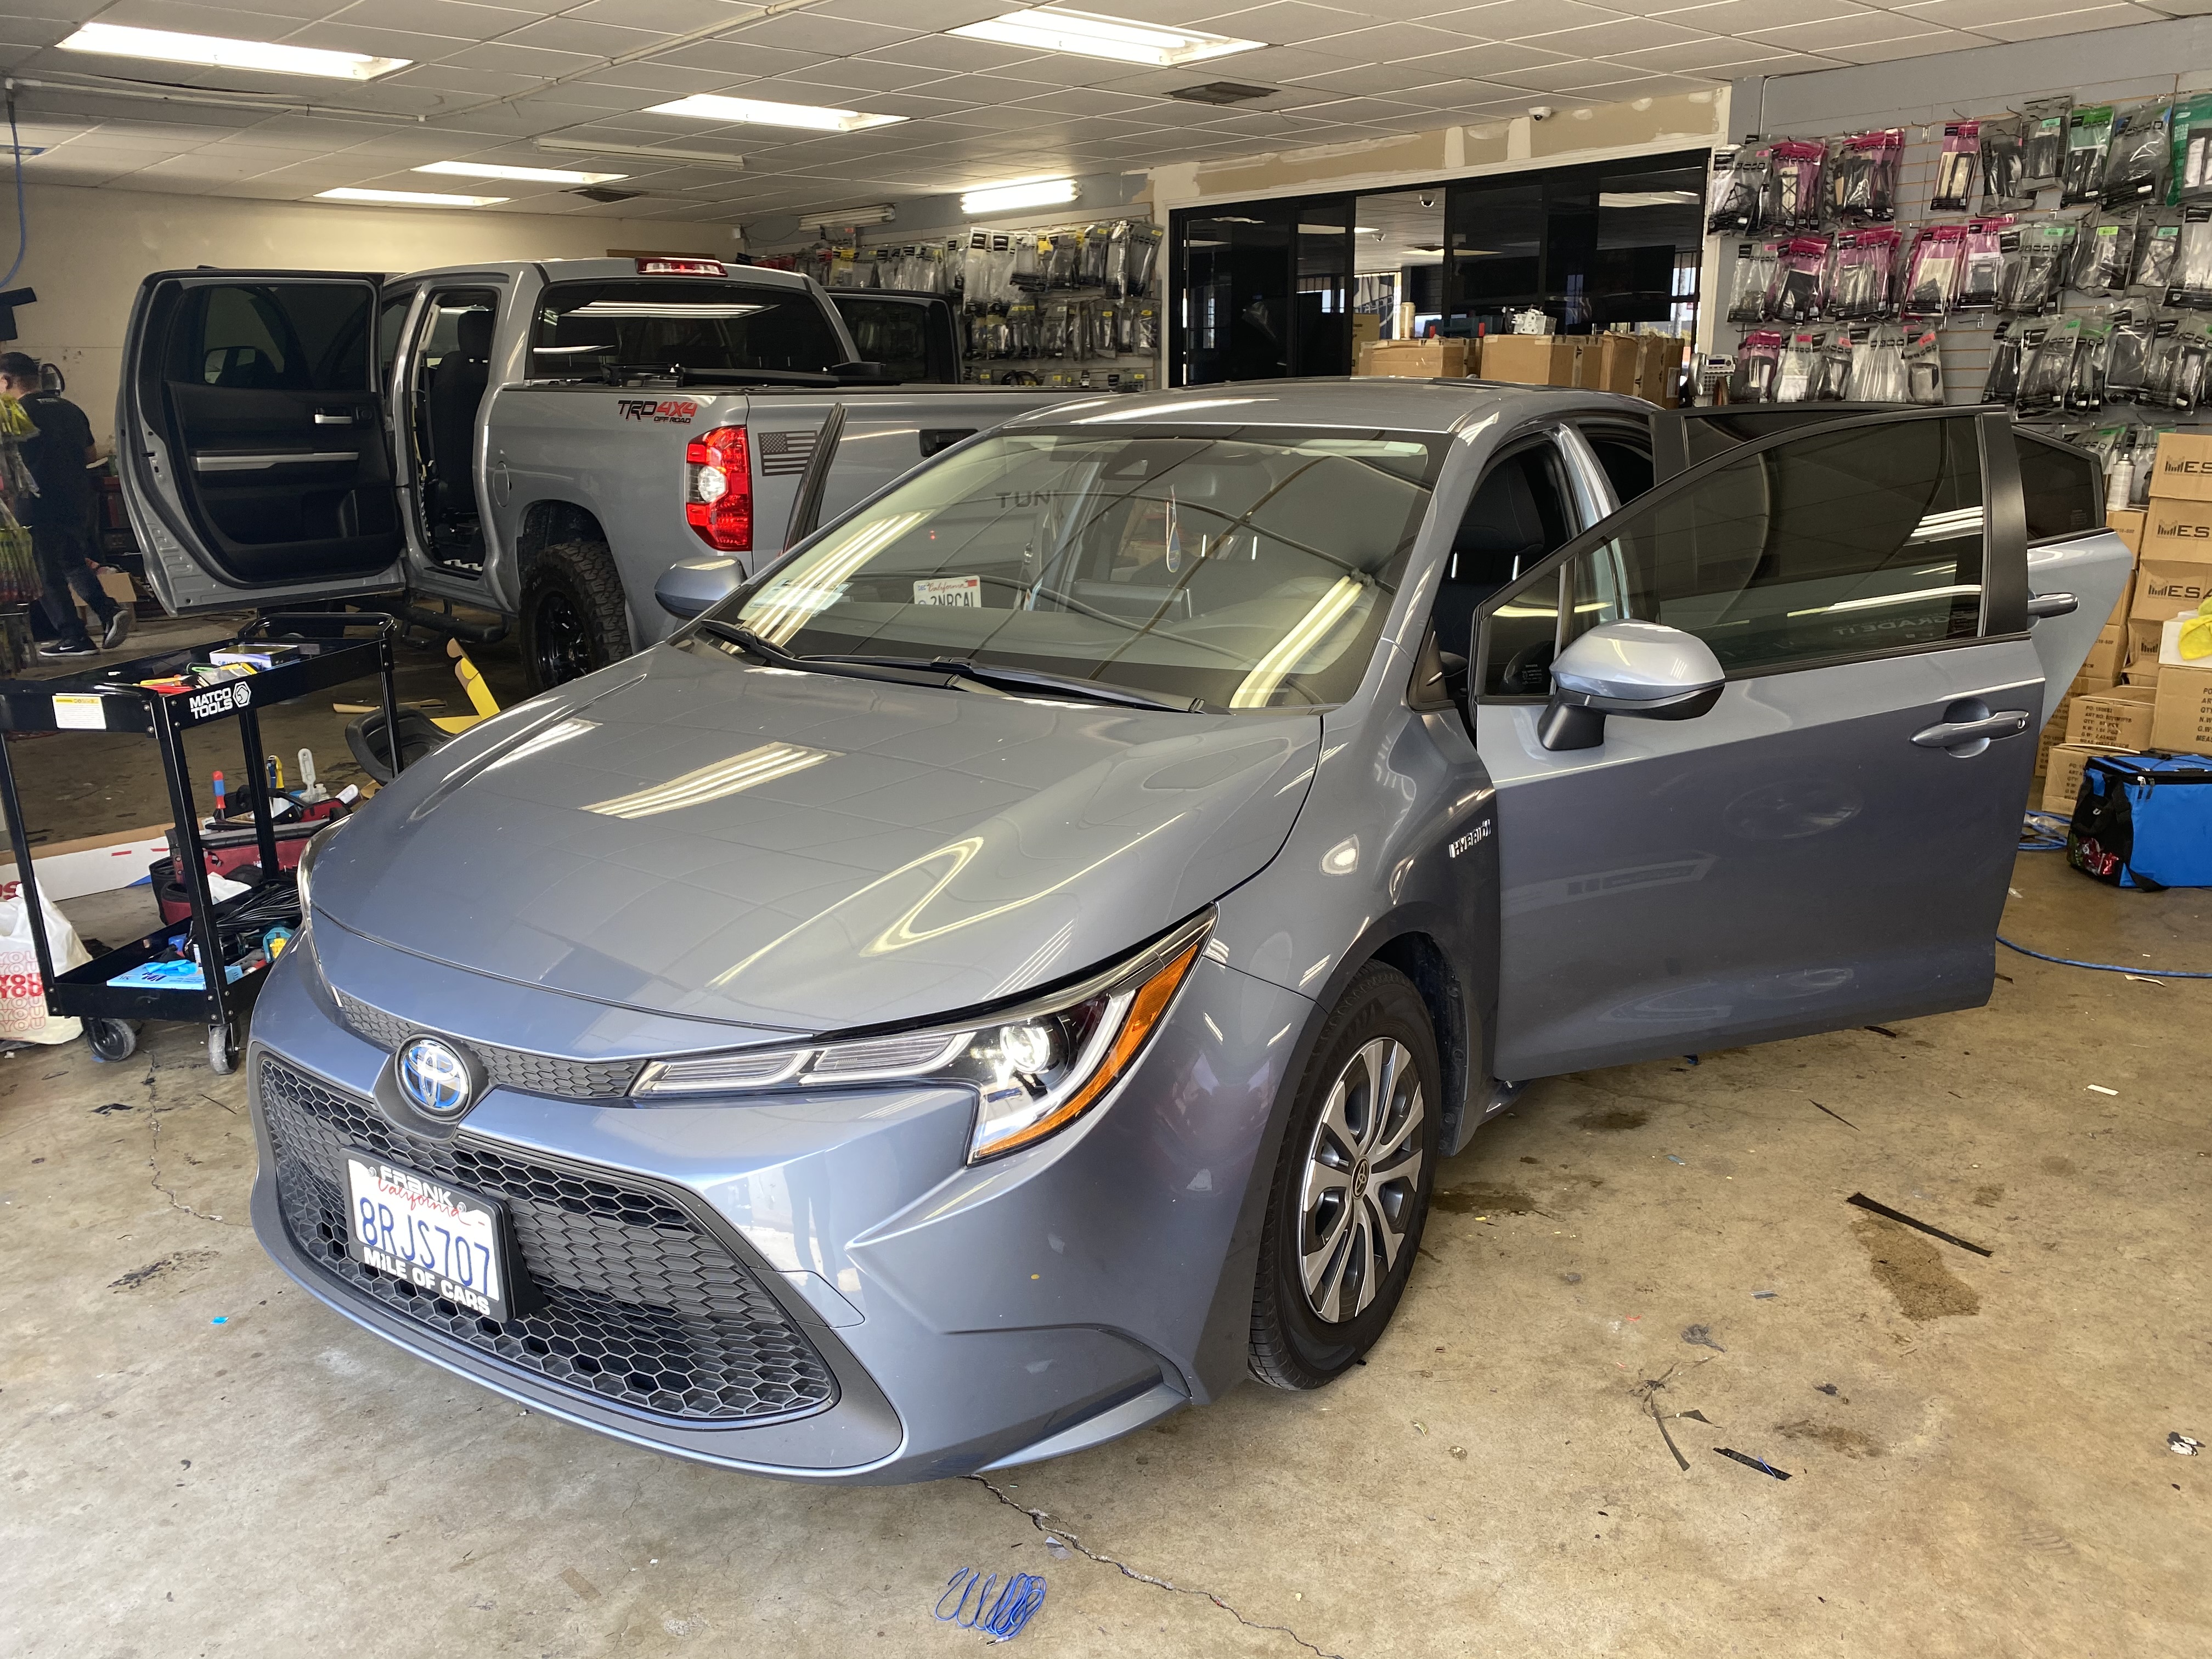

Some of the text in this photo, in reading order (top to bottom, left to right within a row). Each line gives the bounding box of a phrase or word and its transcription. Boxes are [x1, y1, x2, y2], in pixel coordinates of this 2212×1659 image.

[618, 400, 657, 421] TRD
[928, 582, 969, 593] California
[189, 687, 232, 709] MATCO
[191, 698, 233, 719] TOOLS
[0, 996, 44, 1009] YOU
[0, 1006, 45, 1020] YOU
[0, 1017, 46, 1032] YOU
[360, 1197, 490, 1295] 8RJS707
[364, 1246, 490, 1316] MILE OF CARS
